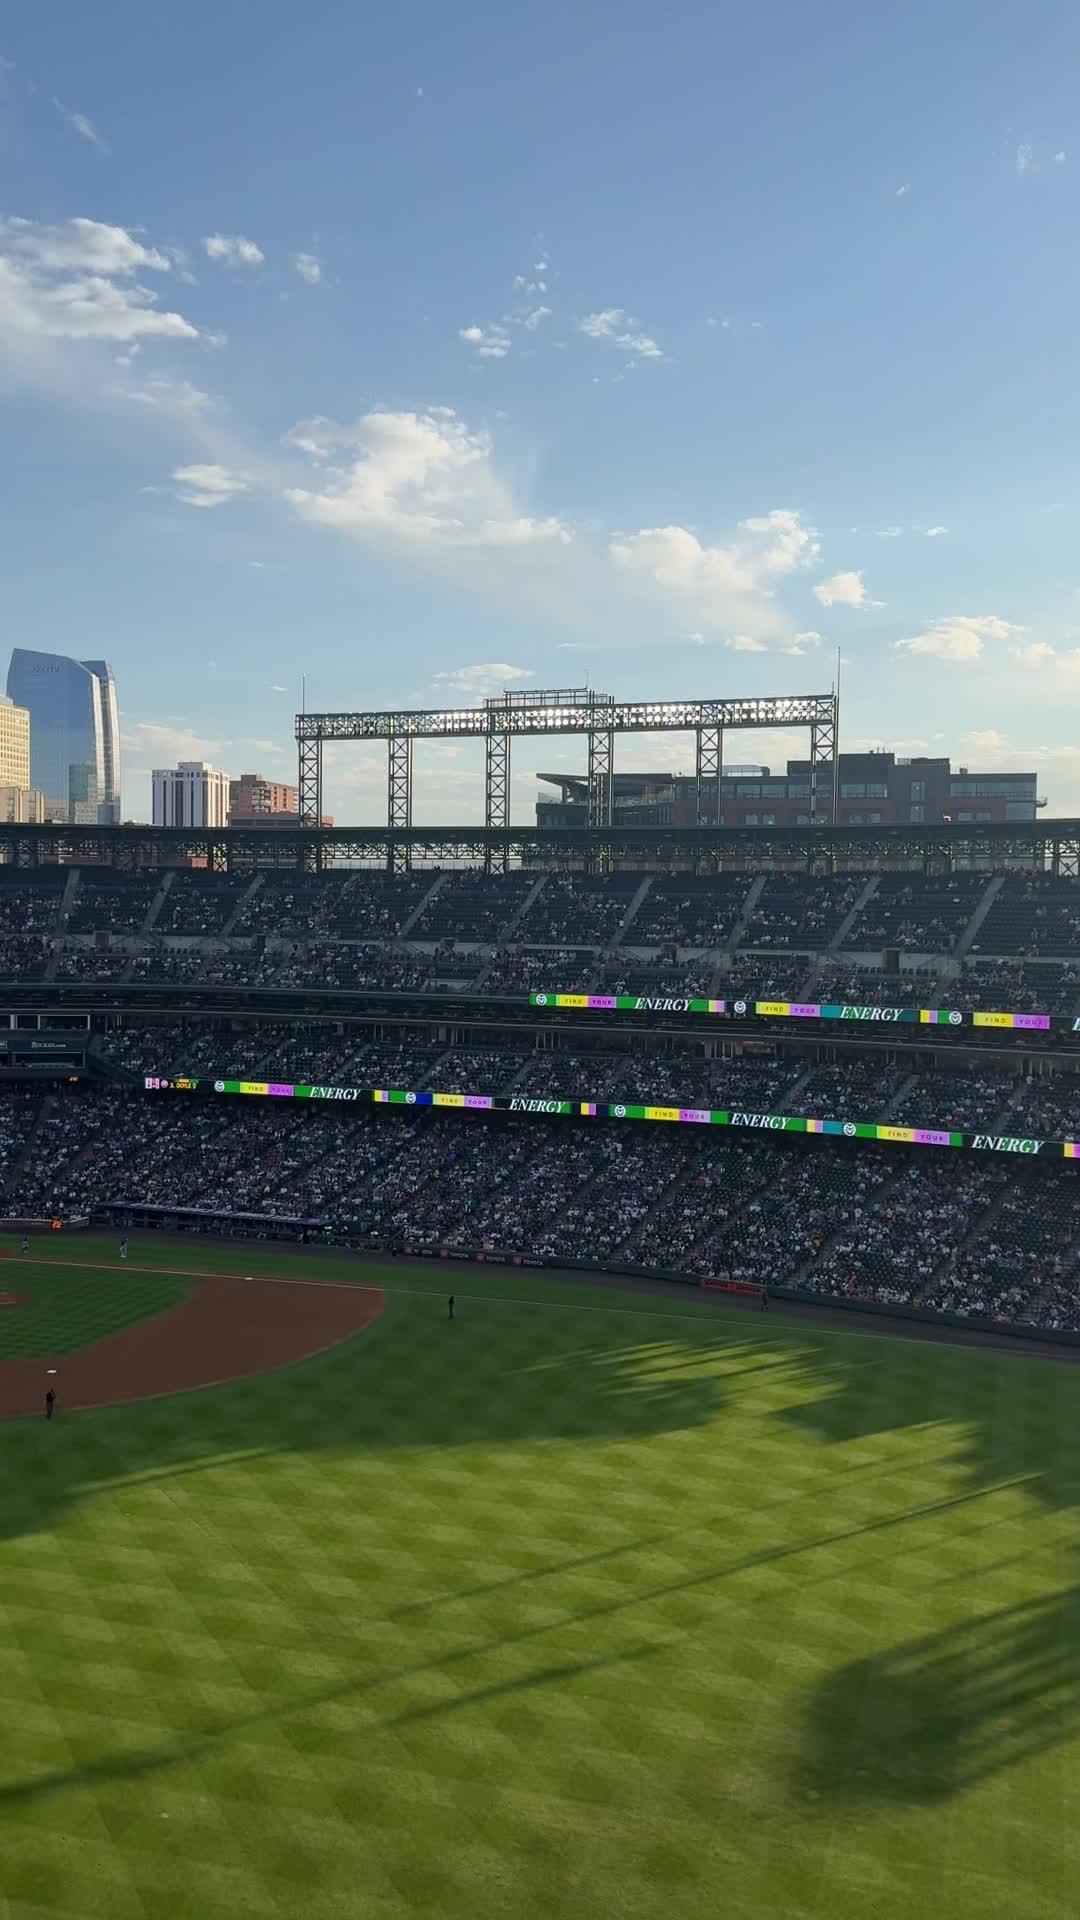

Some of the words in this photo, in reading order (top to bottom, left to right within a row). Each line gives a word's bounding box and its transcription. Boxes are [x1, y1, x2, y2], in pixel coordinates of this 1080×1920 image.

[634, 997, 694, 1012] ENERGY
[765, 1005, 784, 1013] FIND
[839, 1006, 904, 1022] ENERGY
[985, 1016, 1007, 1024] FIND
[308, 1086, 361, 1100] ENERGY
[509, 1098, 567, 1113] ENERGY
[730, 1112, 791, 1130] ENERGY
[887, 1130, 909, 1138] FIND
[921, 1134, 944, 1142] YOUR
[971, 1134, 1045, 1154] ENERGY
[524, 1258, 543, 1266] TOYOTA
